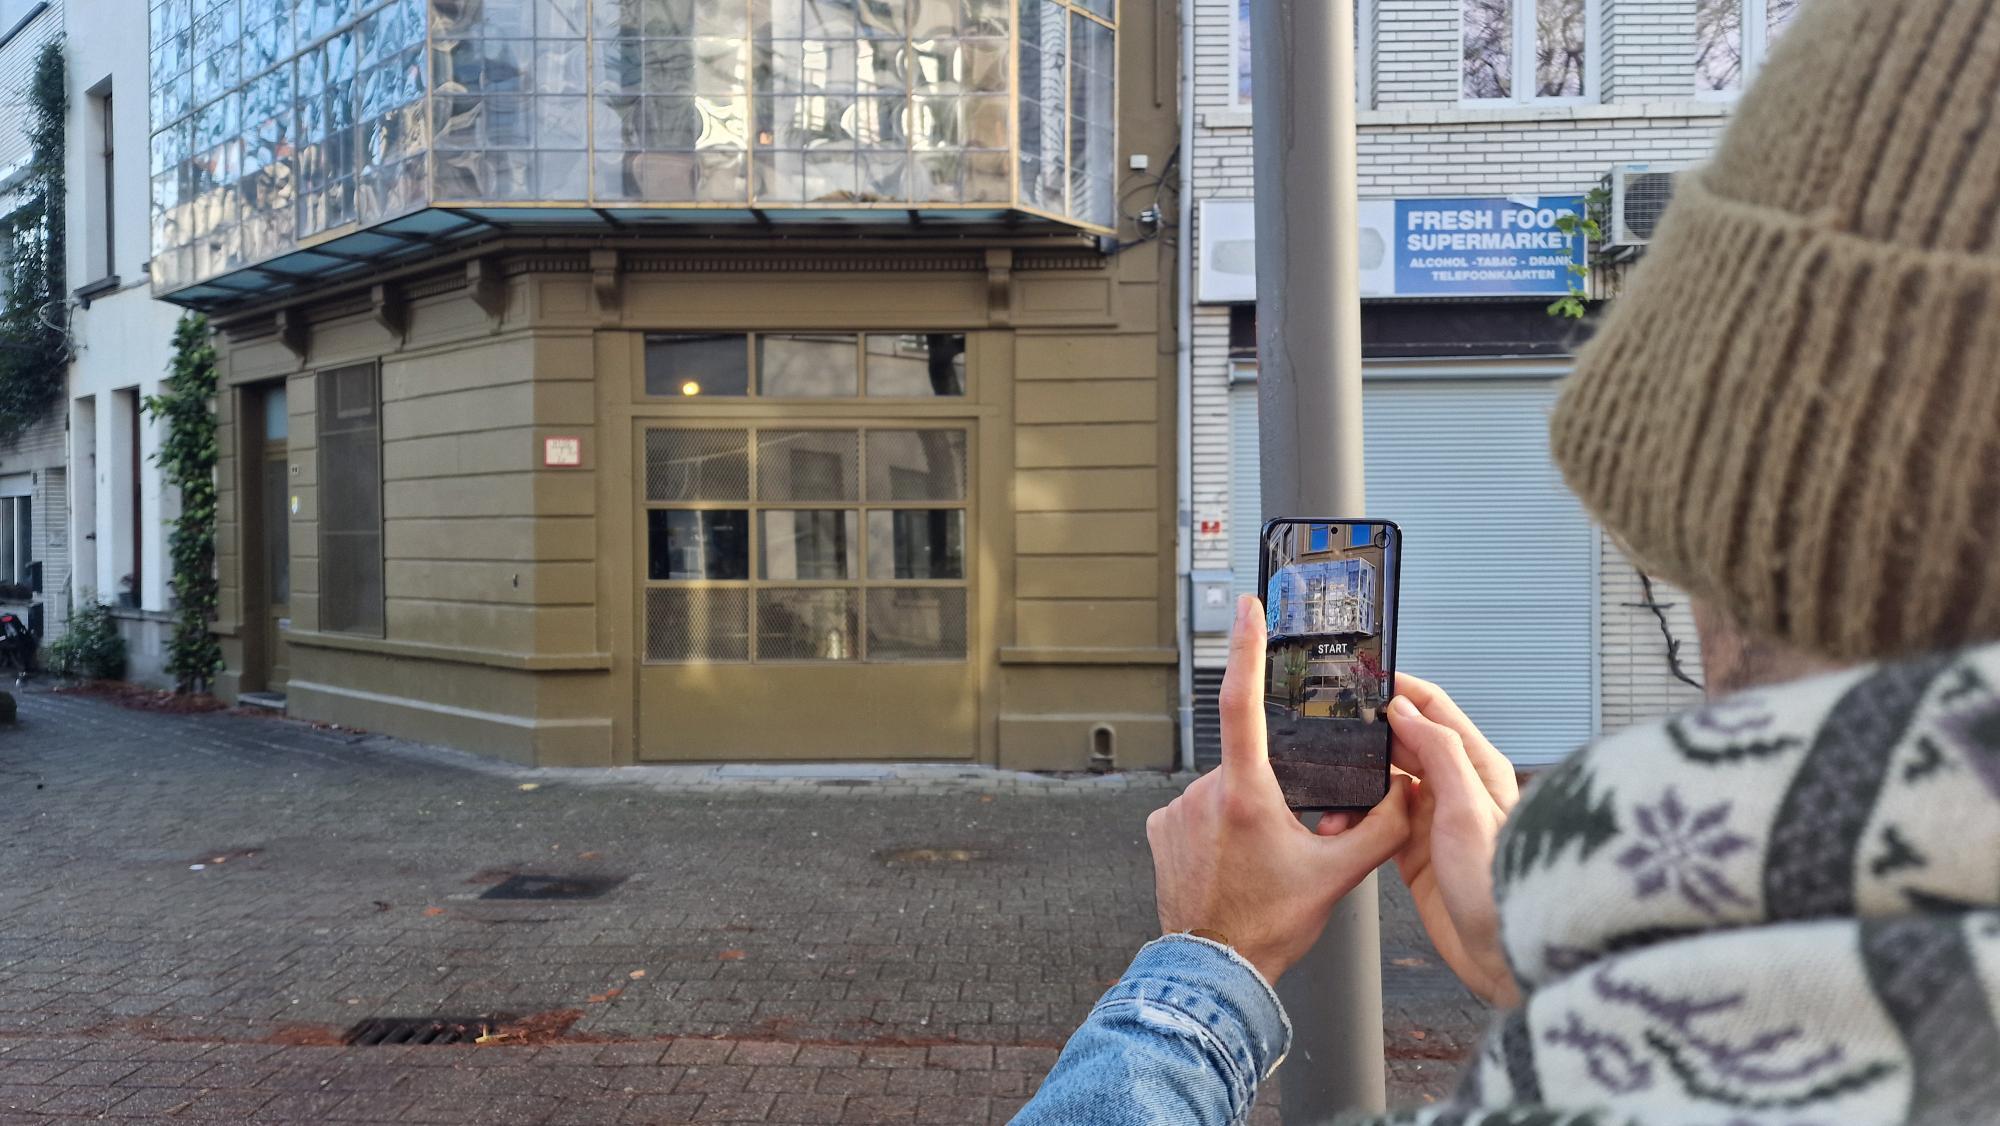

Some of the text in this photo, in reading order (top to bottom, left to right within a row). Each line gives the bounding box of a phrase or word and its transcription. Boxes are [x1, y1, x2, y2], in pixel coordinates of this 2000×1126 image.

[1408, 210, 1493, 230] FRESH
[1407, 232, 1573, 250] SUPERMARKET
[1409, 258, 1469, 268] ALCOHOL
[1529, 256, 1573, 266] DRANK
[1431, 270, 1556, 280] TELEFOONKAARTEN
[1318, 643, 1347, 654] START
